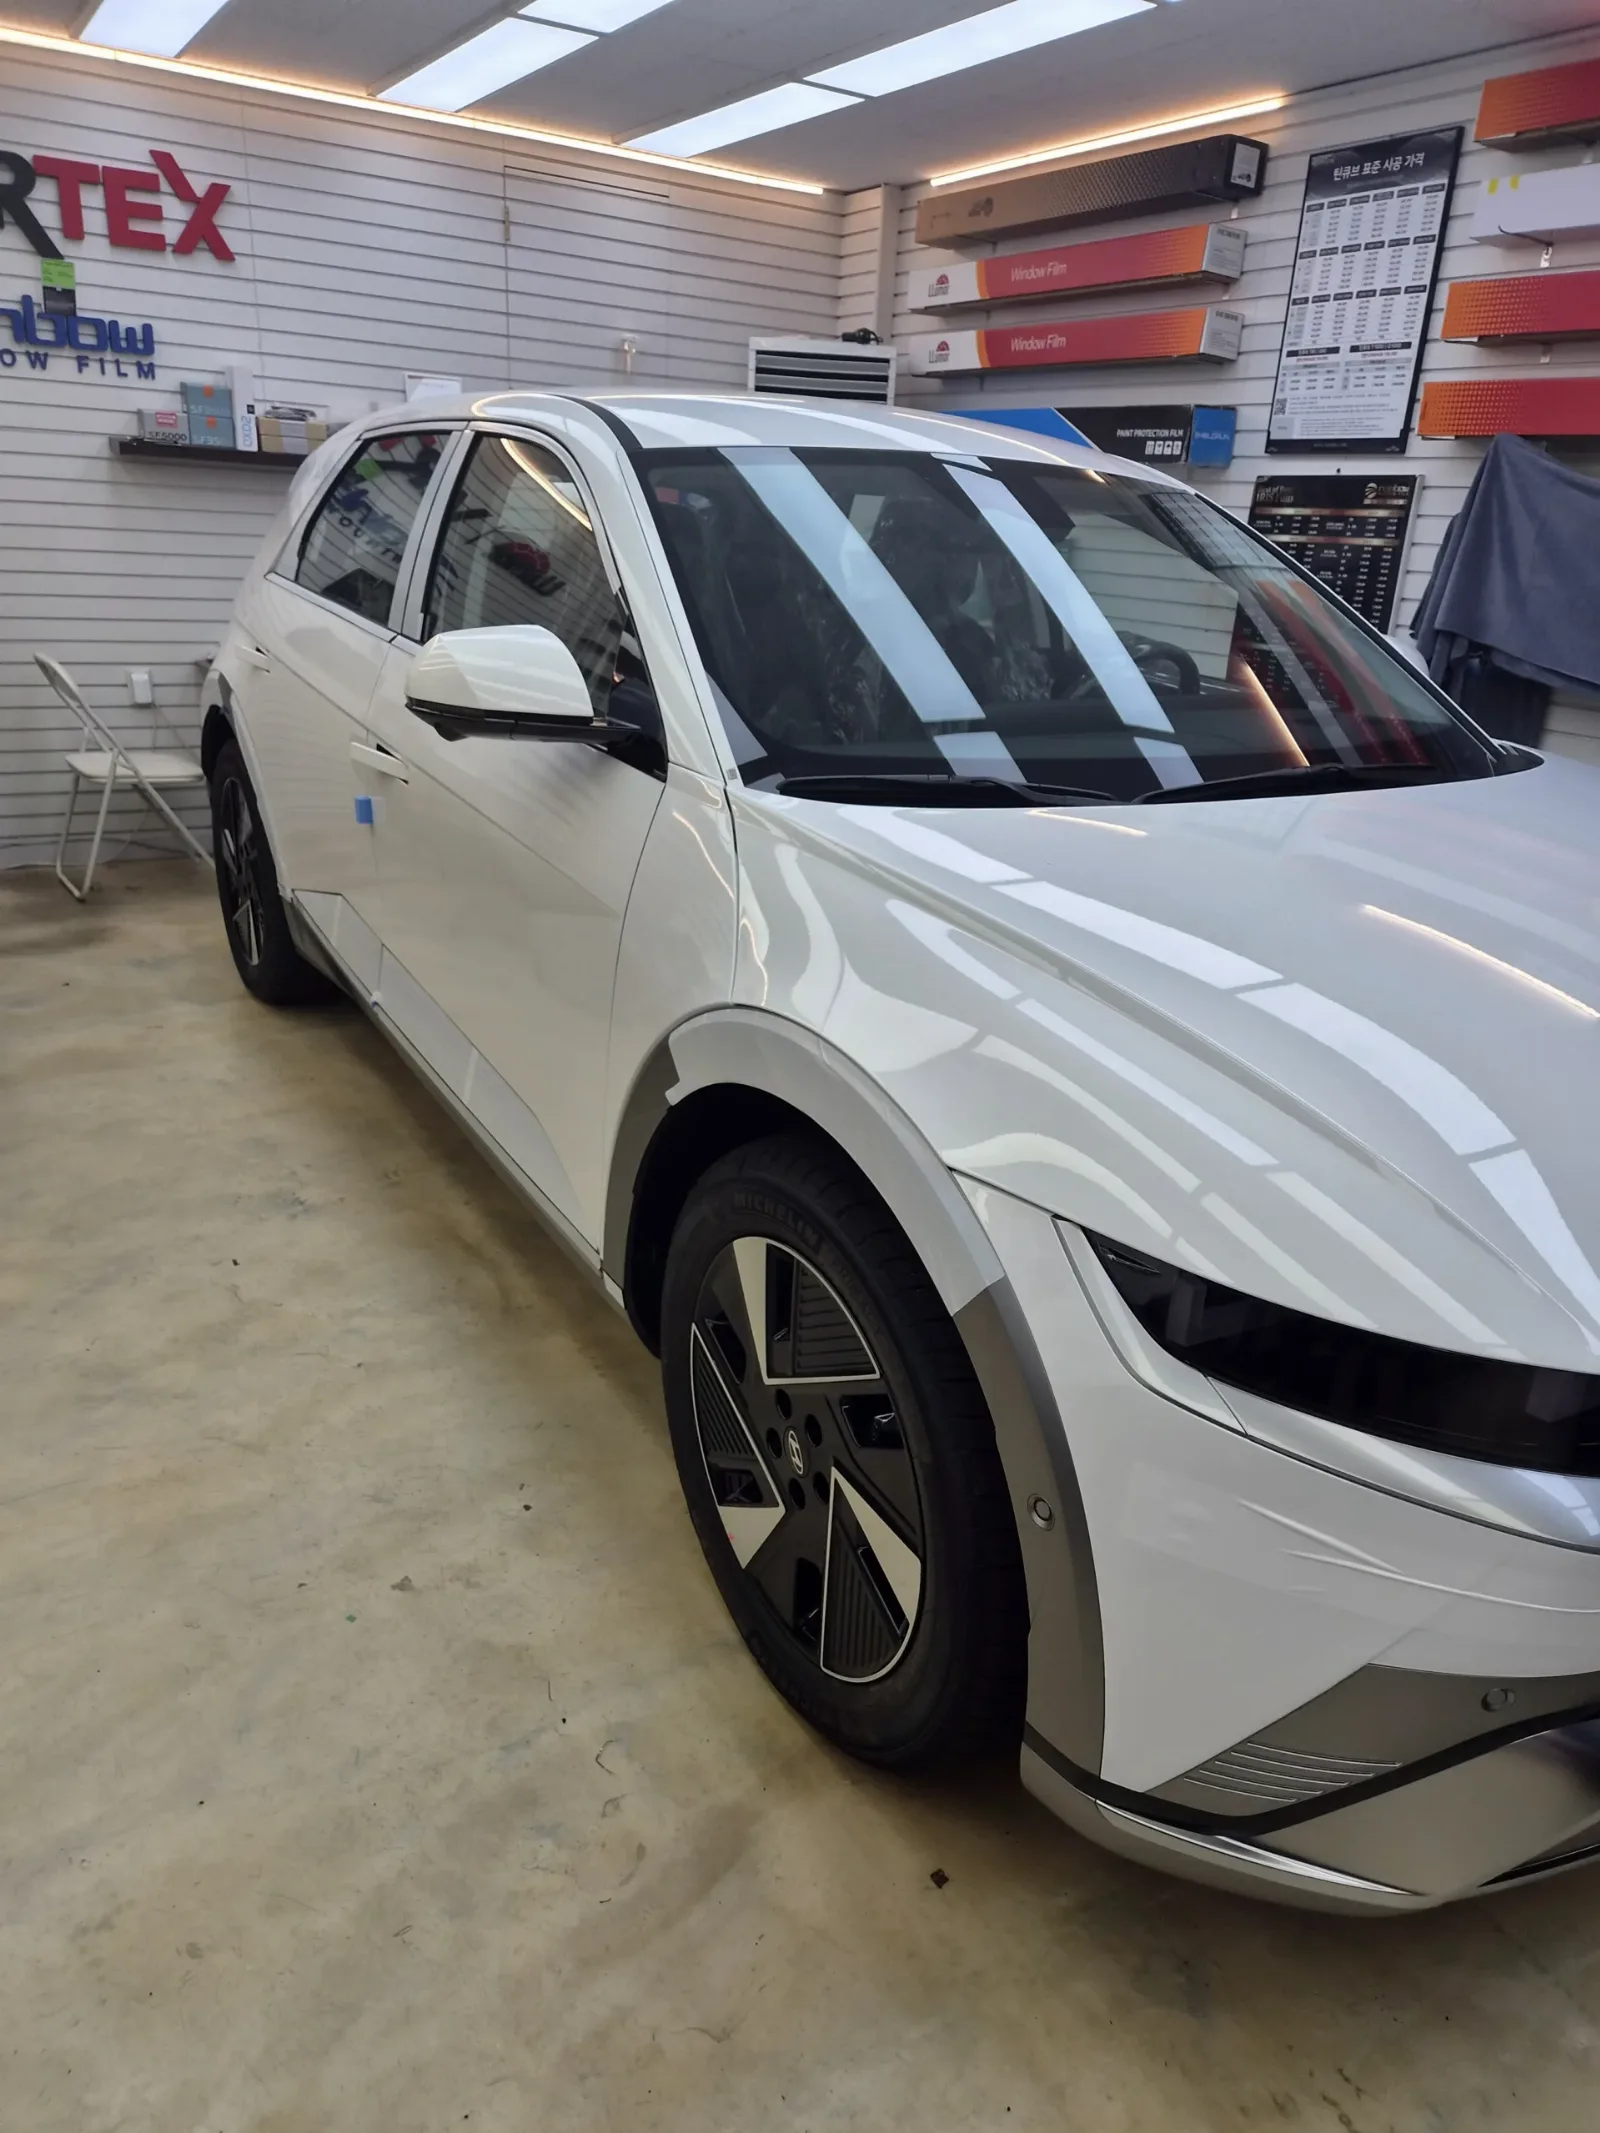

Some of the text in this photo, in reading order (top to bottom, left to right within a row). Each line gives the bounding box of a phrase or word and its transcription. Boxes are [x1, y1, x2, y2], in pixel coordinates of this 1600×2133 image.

[1333, 152, 1425, 181] 틴큐브 표준 시공 가격
[1011, 261, 1068, 282] Window Film
[1011, 333, 1067, 352] Window Film
[76, 355, 156, 380] FILM
[1116, 428, 1184, 437] PAINT PROTECTION FILM
[732, 1191, 820, 1247] MICHELIN
